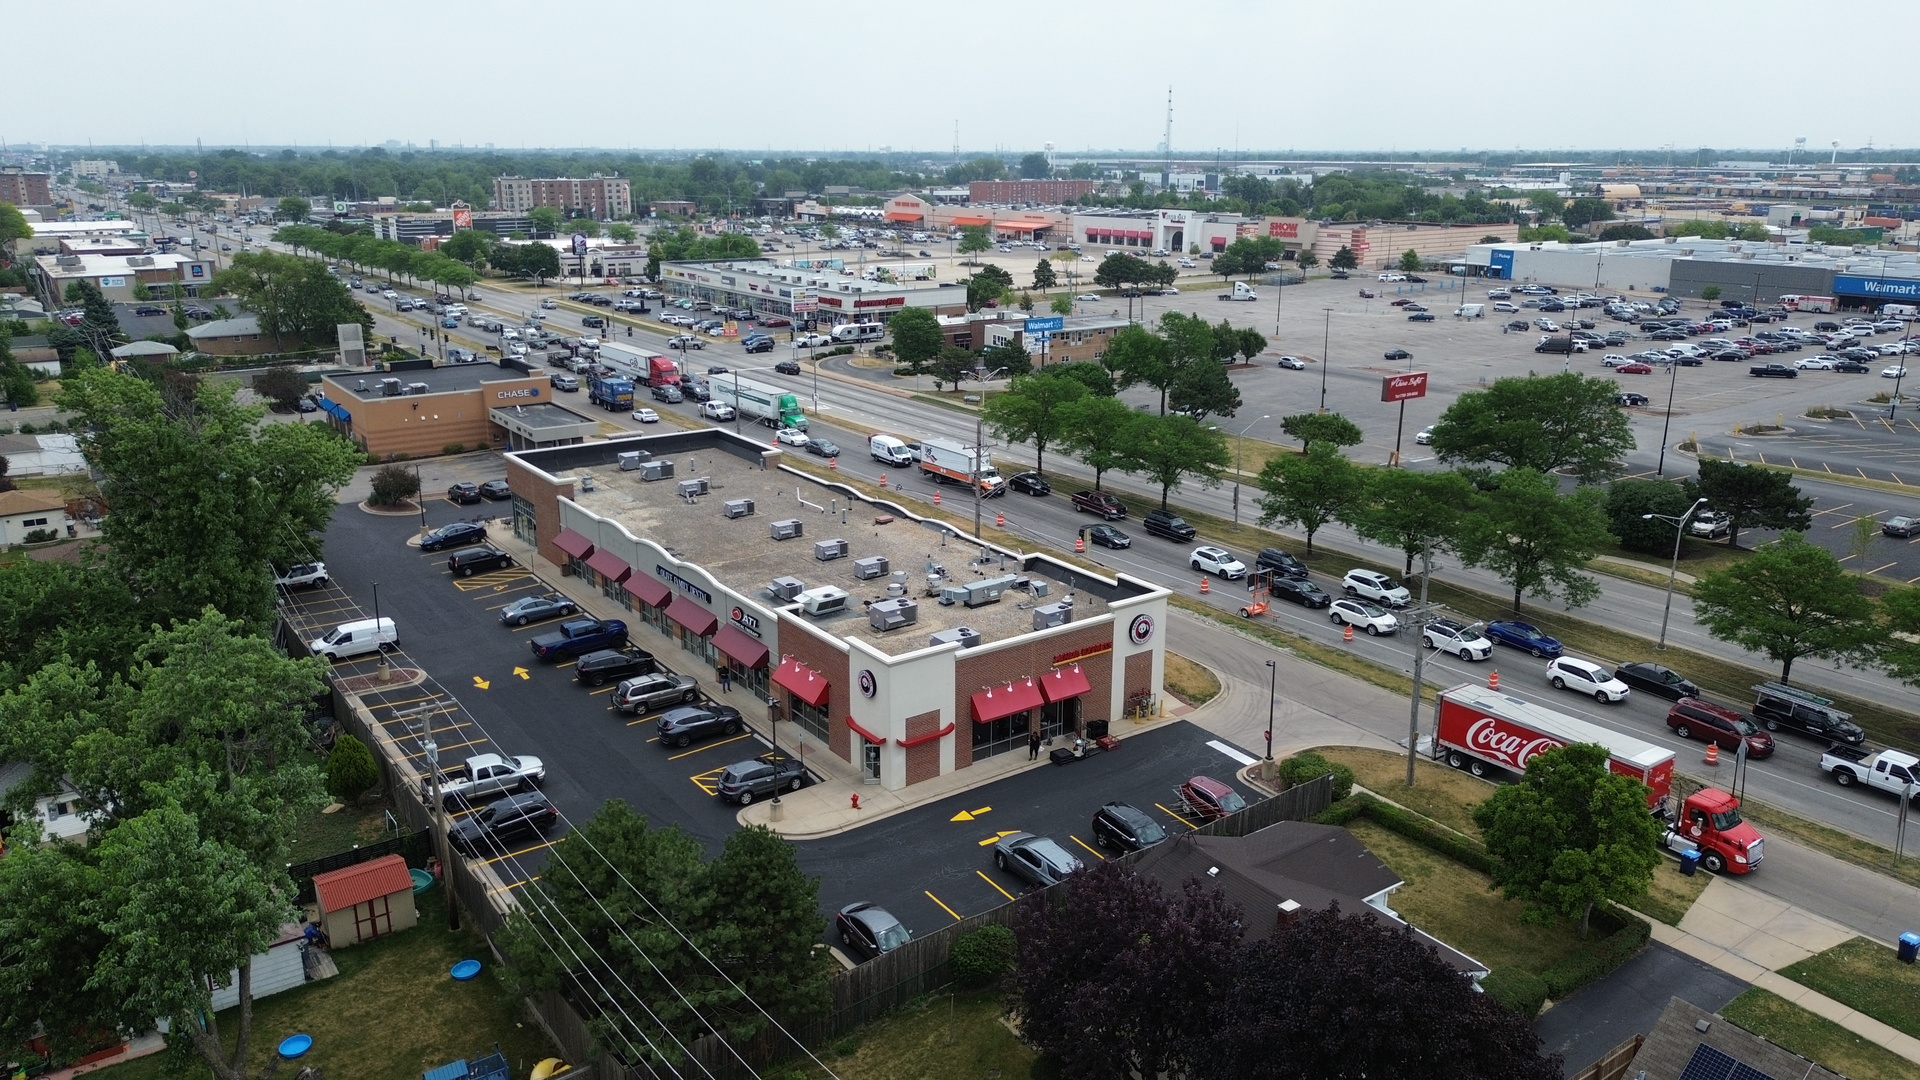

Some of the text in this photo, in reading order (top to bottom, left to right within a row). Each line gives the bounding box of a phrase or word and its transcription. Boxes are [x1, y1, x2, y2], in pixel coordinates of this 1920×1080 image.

[1269, 222, 1299, 231] SHOW
[1864, 281, 1917, 295] Walmart
[853, 297, 906, 308] MATTRESS FIRM
[1028, 321, 1054, 330] Walmart
[497, 389, 530, 399] CHASE
[673, 576, 689, 592] FAMILY
[689, 585, 708, 604] DENTAL
[742, 615, 757, 628] ATI
